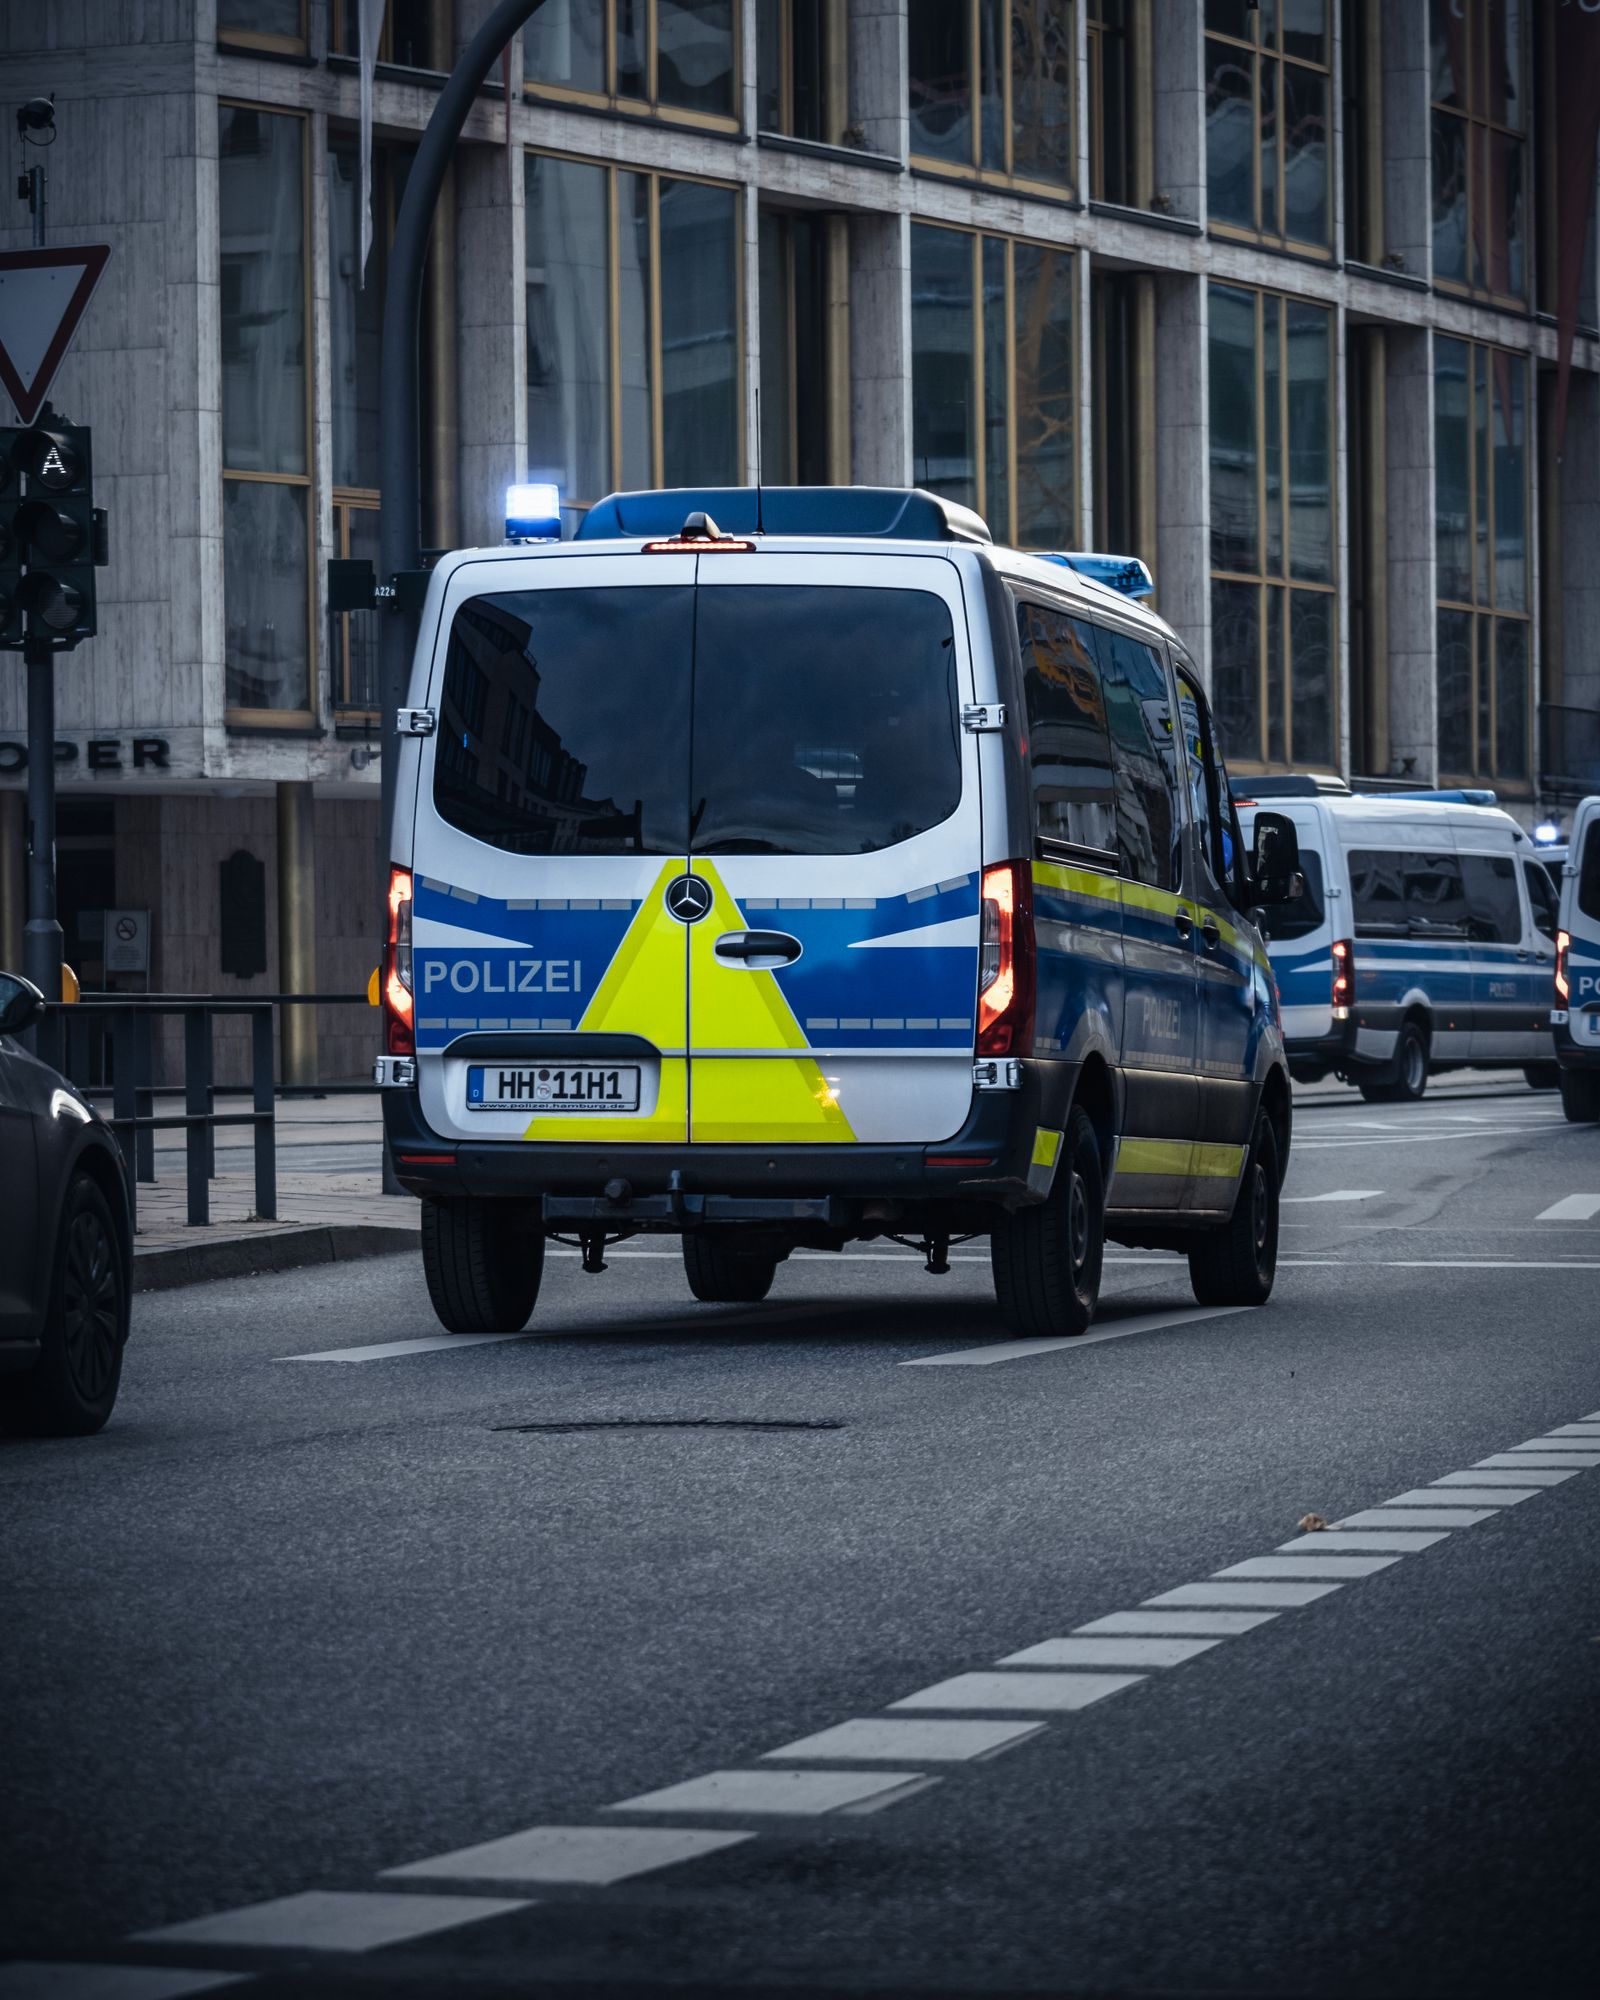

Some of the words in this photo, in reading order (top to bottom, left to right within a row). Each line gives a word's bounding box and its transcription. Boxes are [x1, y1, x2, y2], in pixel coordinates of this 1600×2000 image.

[375, 587, 396, 597] A22a
[424, 960, 582, 993] POLIZEI
[1143, 996, 1182, 1040] POLIZEI
[499, 1071, 535, 1099] HH
[552, 1071, 622, 1099] 11H1
